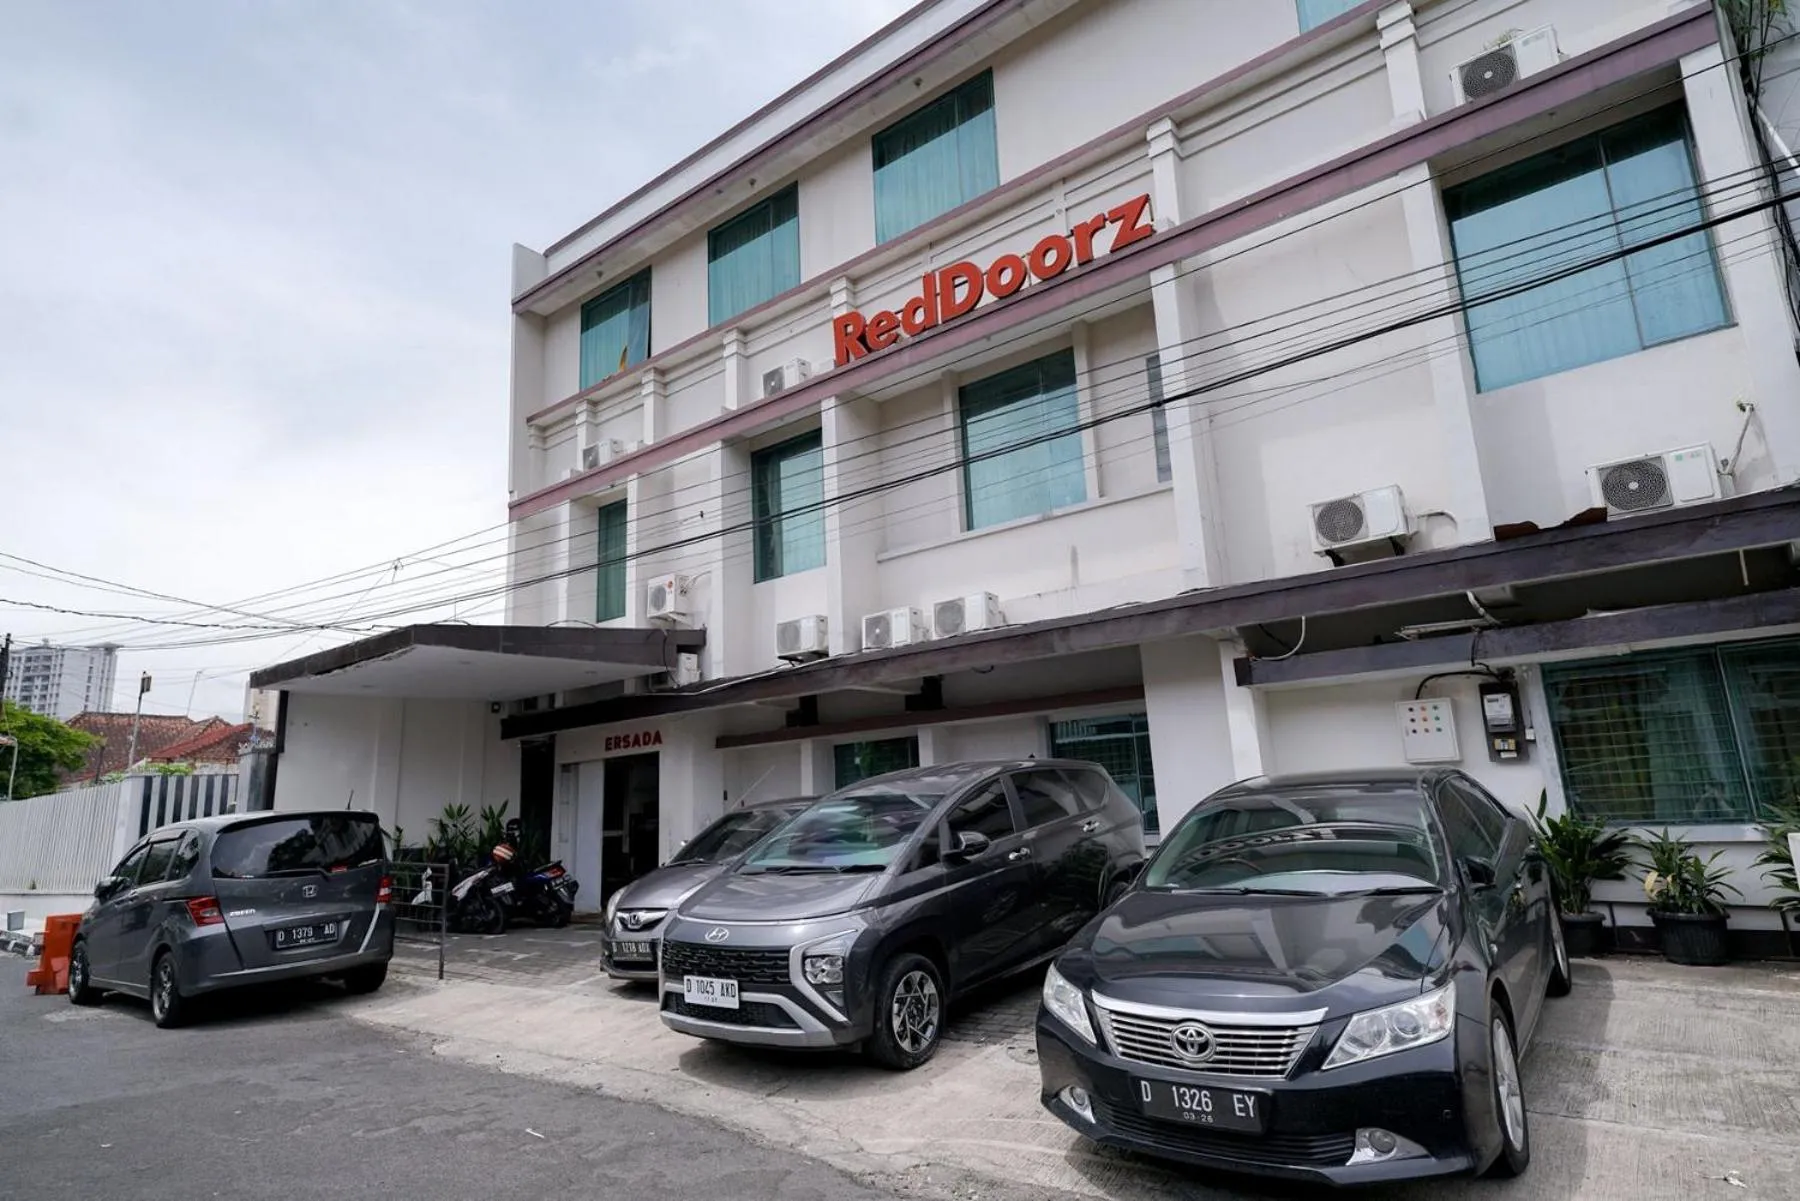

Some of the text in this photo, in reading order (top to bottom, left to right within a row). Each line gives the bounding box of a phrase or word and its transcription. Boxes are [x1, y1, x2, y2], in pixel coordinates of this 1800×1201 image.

[833, 193, 1154, 366] RedDoorz
[605, 730, 662, 751] ERSADA
[292, 926, 313, 940] 1379
[686, 978, 692, 993] D
[696, 979, 715, 996] 1045
[1141, 1080, 1255, 1118] D 1326 EY
